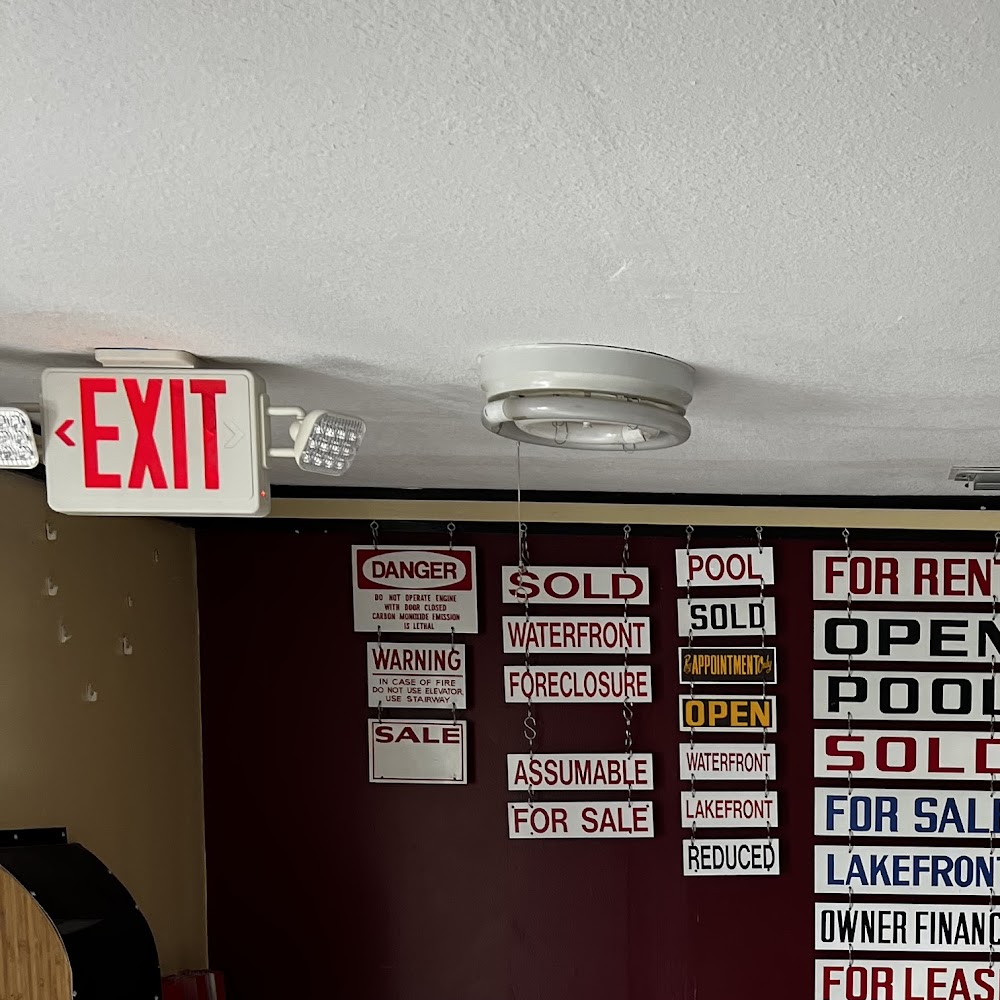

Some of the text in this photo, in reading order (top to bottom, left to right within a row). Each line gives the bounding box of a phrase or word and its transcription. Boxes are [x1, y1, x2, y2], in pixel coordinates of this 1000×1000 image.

[79, 378, 226, 489] EXIT
[372, 561, 457, 579] DANGER
[688, 554, 762, 580] POOL
[825, 557, 898, 595] FOR
[509, 572, 643, 599] SOLD
[691, 603, 765, 630] SOLD
[508, 622, 645, 649] WATERFRONT
[372, 649, 461, 671] WARNING
[692, 655, 759, 675] APPOINTMENT
[510, 672, 647, 698] FORECLOSURE
[685, 701, 770, 726] OPEN
[375, 726, 460, 743] SALE
[514, 760, 647, 785] ASSUMABLE
[687, 752, 770, 772] WATERFRONT
[514, 807, 648, 834] FOR SALE
[686, 800, 772, 819] LAKEFRONT
[826, 795, 897, 832] FOR
[688, 845, 774, 871] REDUCED
[821, 910, 907, 944] OWNER
